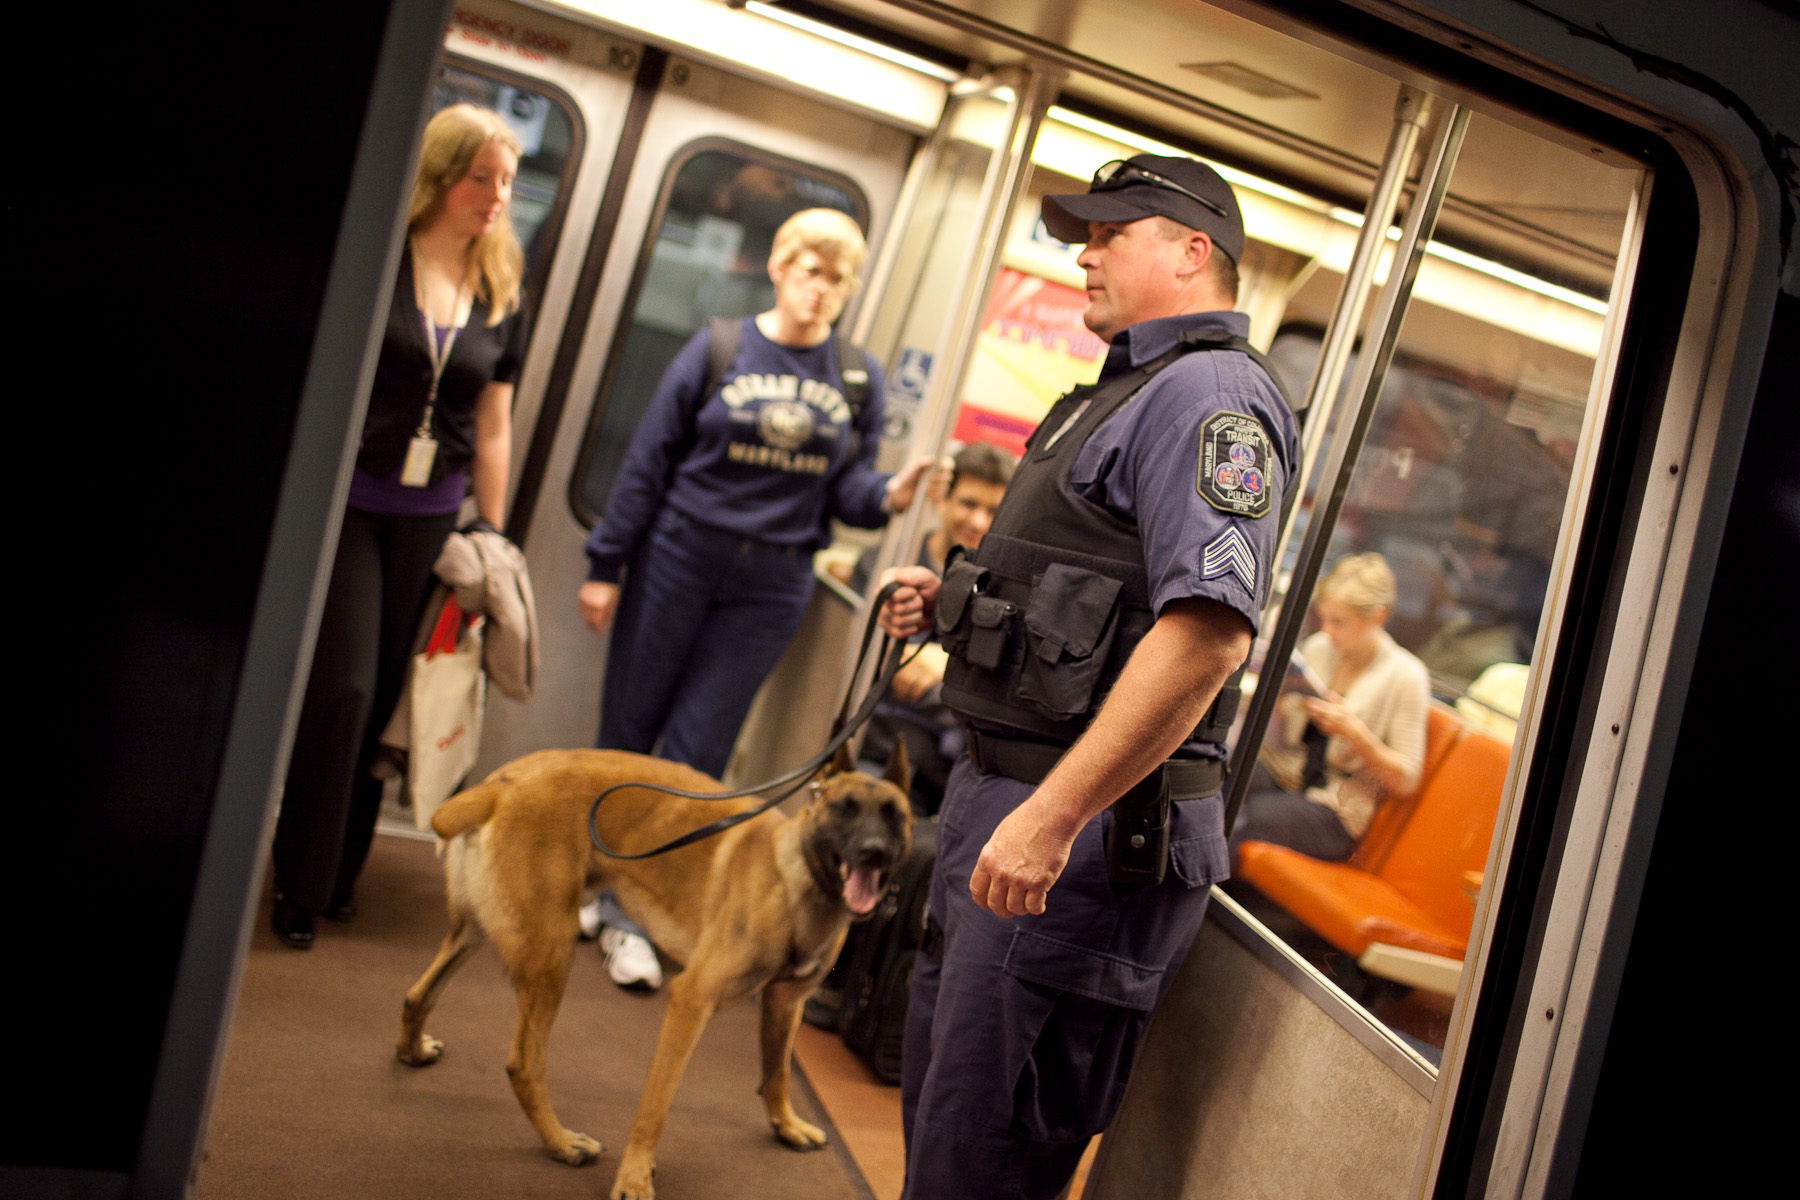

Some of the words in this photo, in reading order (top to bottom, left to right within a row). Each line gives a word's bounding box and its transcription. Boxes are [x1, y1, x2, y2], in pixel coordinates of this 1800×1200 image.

[1225, 430, 1260, 447] TRANSIT
[728, 442, 829, 475] MARYLAND
[1204, 442, 1213, 478] MARYLAND
[1227, 490, 1255, 504] POLICE
